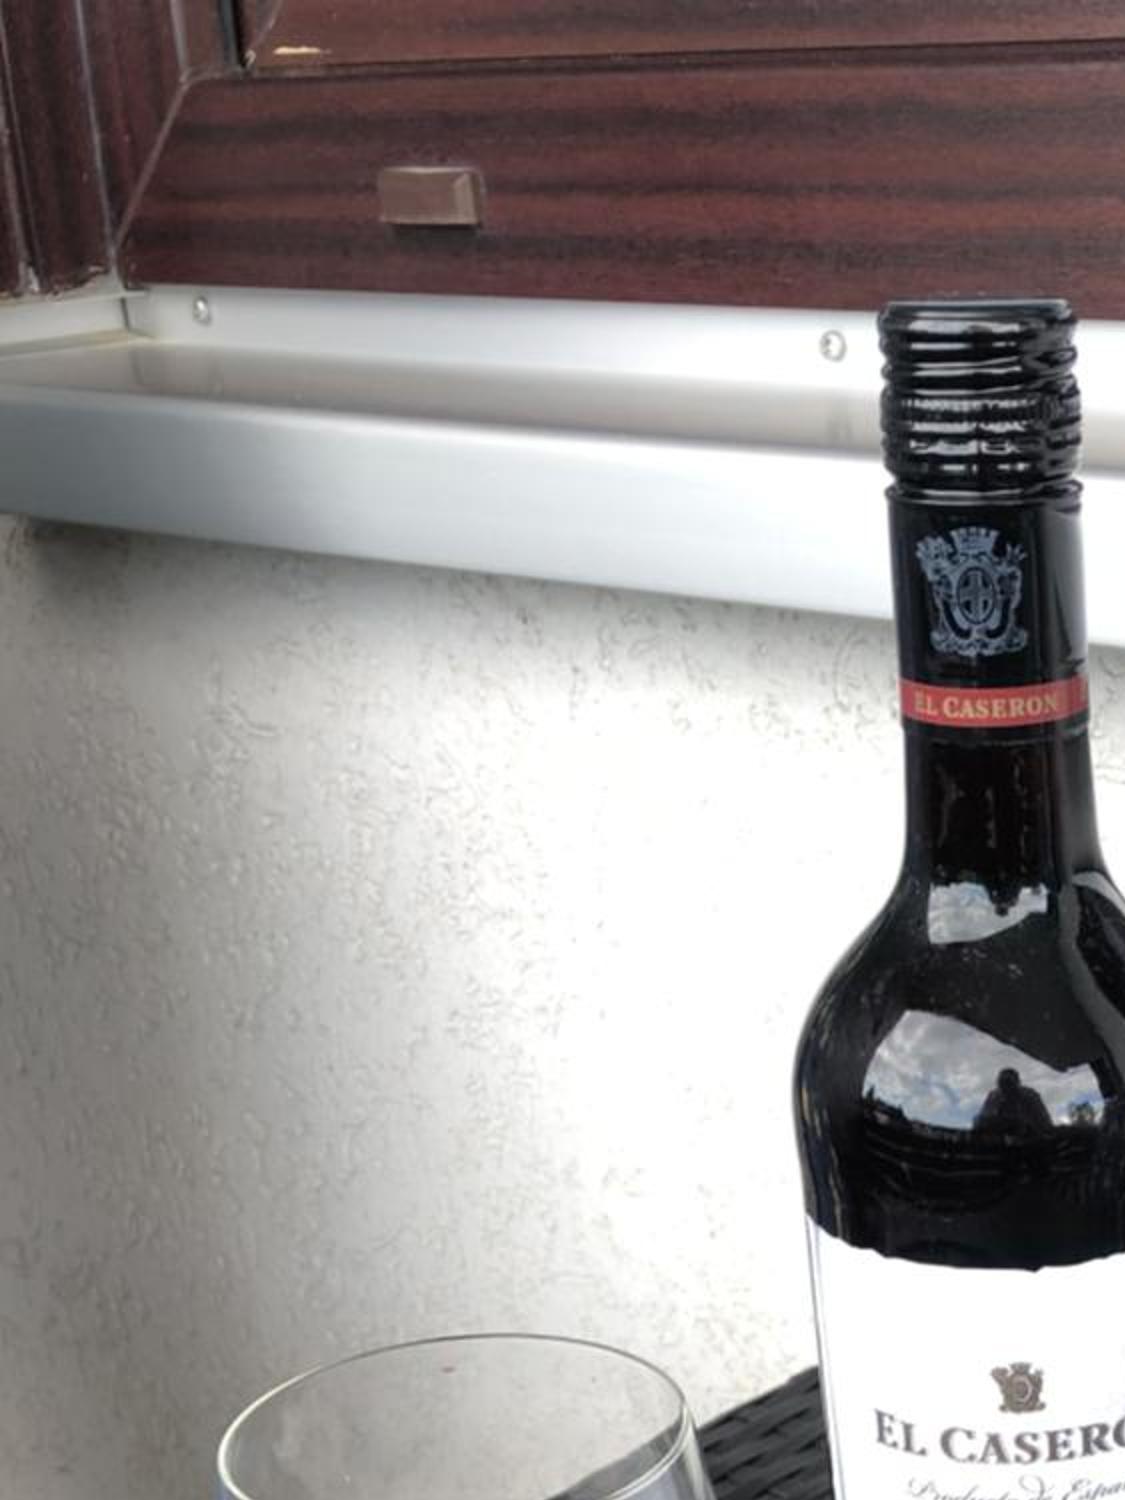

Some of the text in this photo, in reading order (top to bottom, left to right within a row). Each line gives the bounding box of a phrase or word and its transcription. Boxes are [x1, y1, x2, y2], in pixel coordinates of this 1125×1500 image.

[914, 688, 1058, 719] EL CASERON
[873, 1408, 928, 1457] EL
